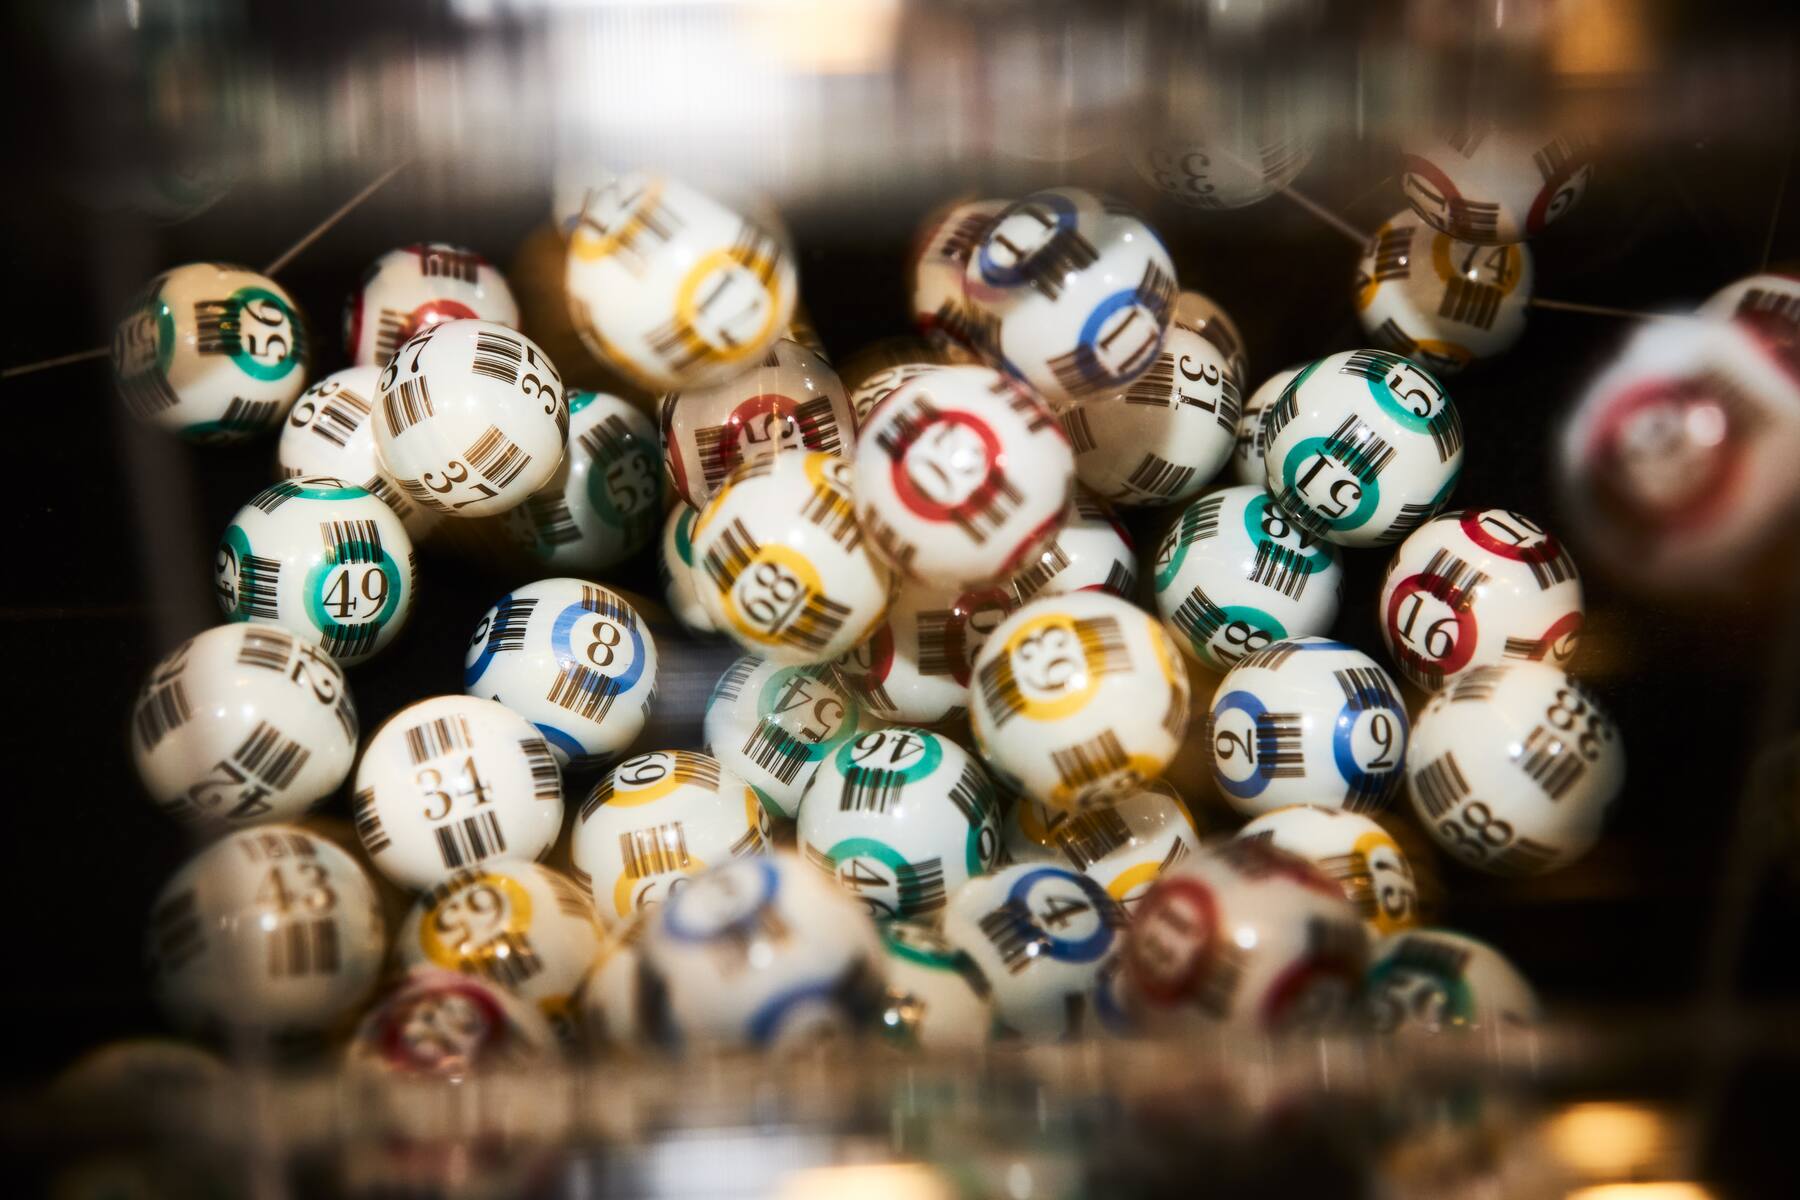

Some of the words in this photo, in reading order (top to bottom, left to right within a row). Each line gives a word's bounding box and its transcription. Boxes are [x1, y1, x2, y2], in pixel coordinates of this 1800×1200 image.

[996, 206, 1057, 259] 11
[246, 299, 289, 363] 56
[1100, 308, 1158, 376] 11
[381, 335, 434, 393] 37
[521, 345, 561, 415] 37
[1174, 354, 1220, 415] 31
[1389, 365, 1444, 417] 51
[424, 460, 499, 509] 37
[605, 453, 658, 513] 53
[1296, 449, 1363, 519] 51
[1479, 509, 1546, 546] 16
[322, 568, 389, 618] 49
[740, 561, 803, 630] 68
[586, 622, 621, 667] 8
[1397, 592, 1460, 659] 16
[291, 645, 342, 705] 42
[1018, 624, 1078, 692] 63
[775, 672, 845, 744] 54
[619, 751, 669, 785] 69
[848, 732, 925, 765] 46
[1367, 713, 1393, 768] 9
[188, 761, 273, 819] 42
[415, 756, 492, 821] 34
[1439, 801, 1514, 862] 38
[255, 867, 337, 915] 43
[436, 885, 504, 947] 65
[1040, 894, 1091, 931] 4
